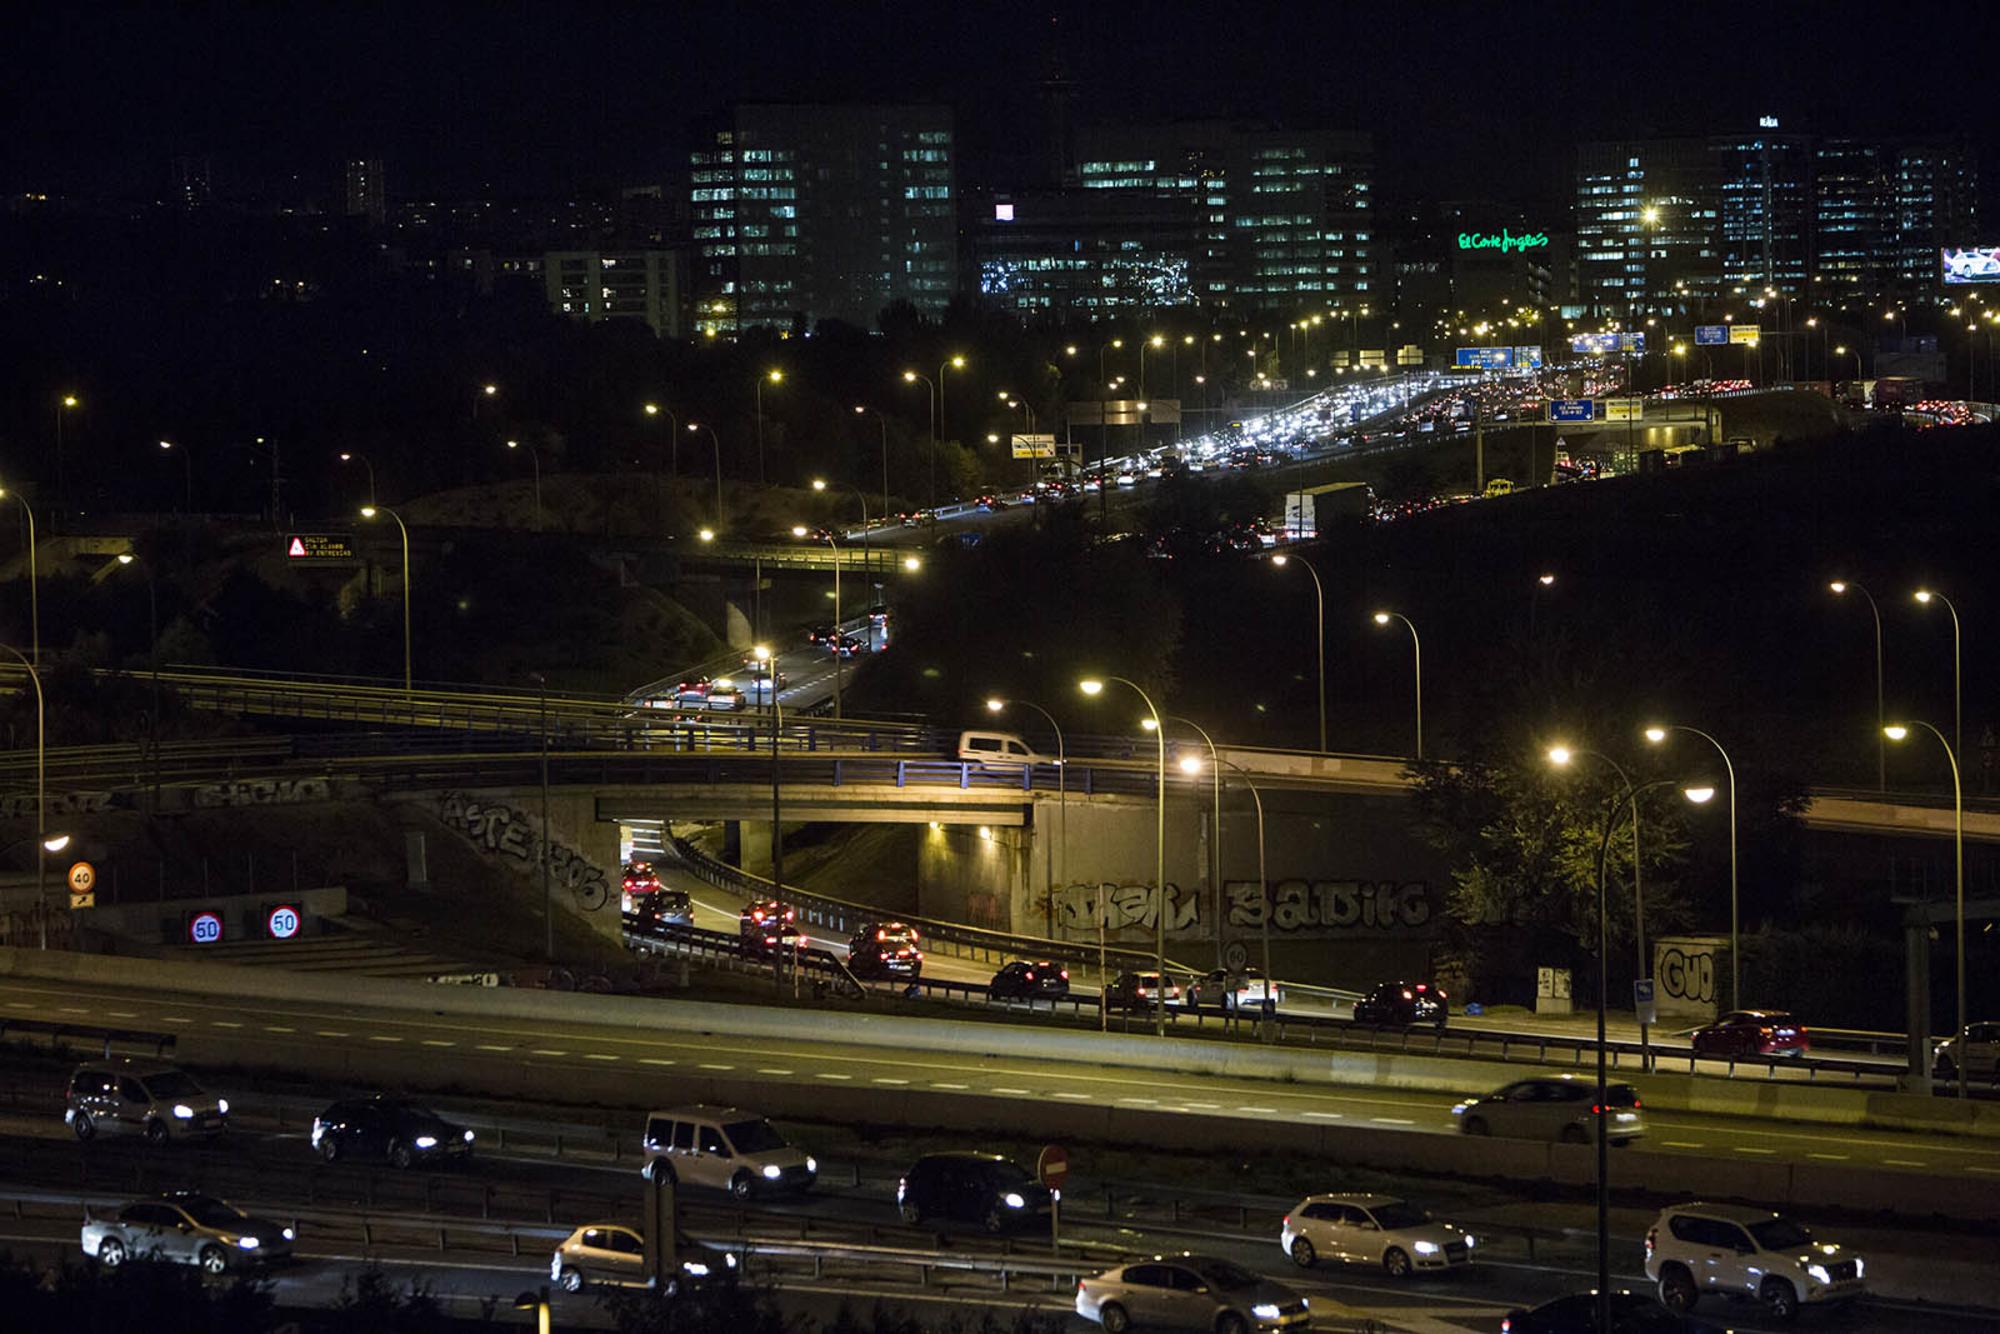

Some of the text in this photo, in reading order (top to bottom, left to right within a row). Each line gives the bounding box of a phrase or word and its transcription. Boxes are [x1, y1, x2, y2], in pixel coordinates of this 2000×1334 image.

[1458, 227, 1548, 253] El Corte Inglés
[74, 873, 90, 884] 40
[196, 920, 218, 939] 50
[273, 914, 294, 931] 50
